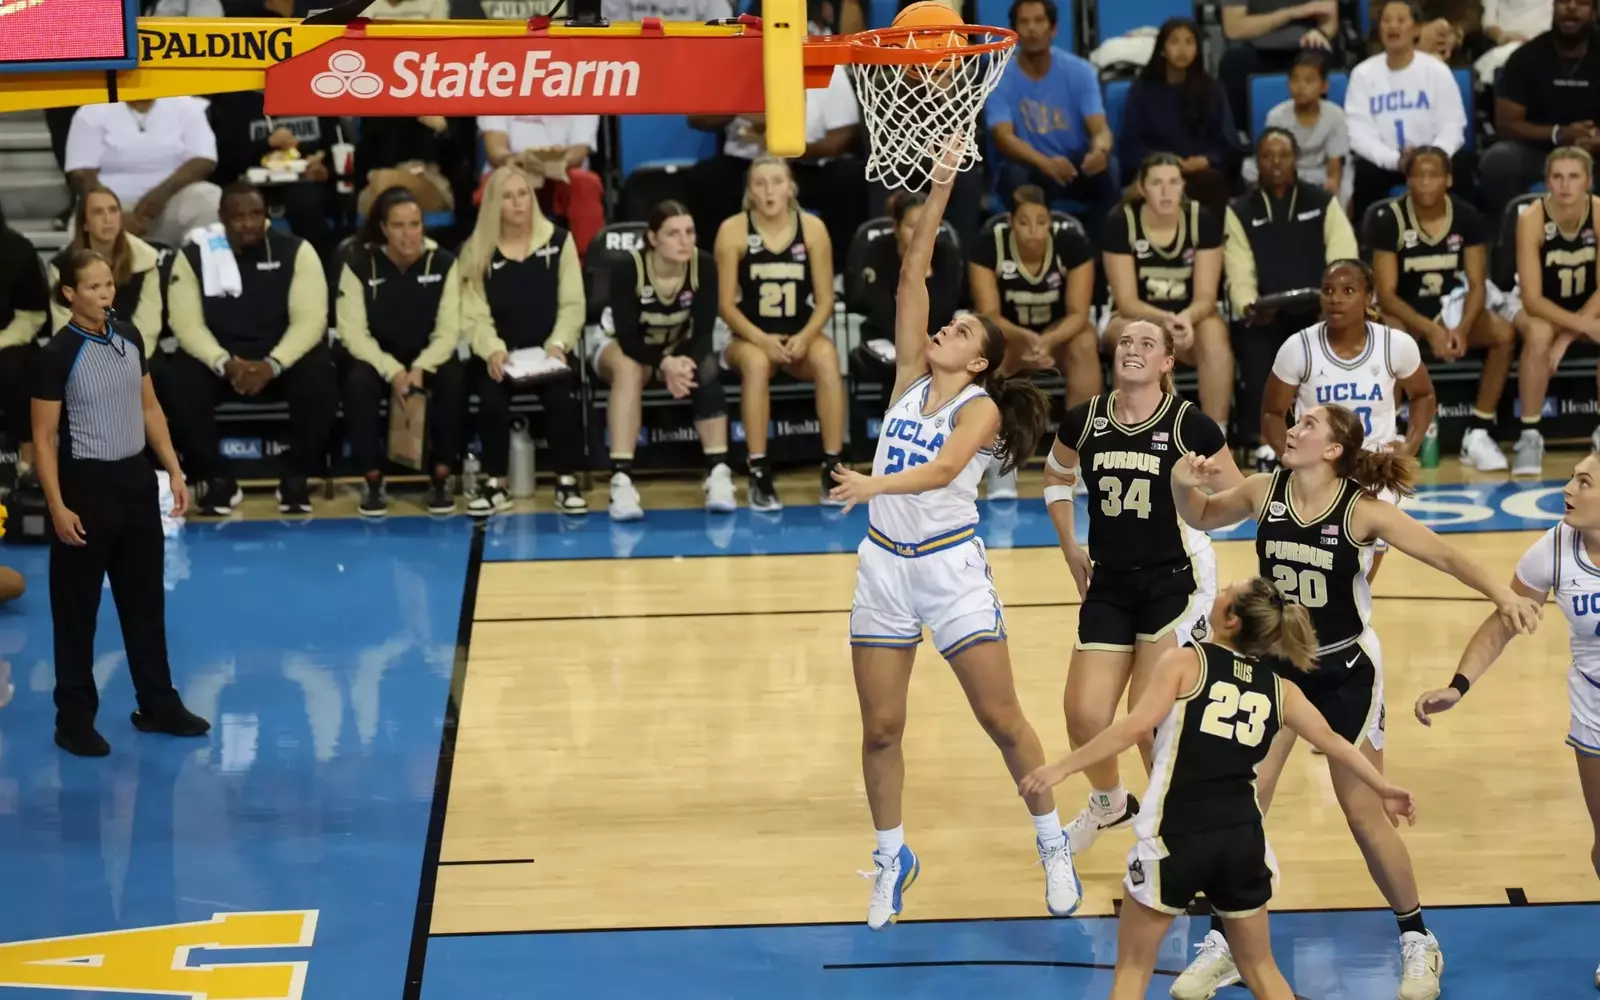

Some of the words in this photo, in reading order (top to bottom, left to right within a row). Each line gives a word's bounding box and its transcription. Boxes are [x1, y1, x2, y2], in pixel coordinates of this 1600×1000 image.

[138, 27, 292, 62] PALDING
[1369, 89, 1430, 115] UCLA
[1558, 265, 1586, 298] 11
[758, 282, 796, 317] 21
[1316, 383, 1383, 404] UCLA
[886, 418, 944, 452] UCLA
[1092, 451, 1161, 476] PURDUE
[1098, 476, 1152, 519] 34
[1265, 540, 1334, 570] PURDUE
[1272, 564, 1328, 608] 20
[1233, 659, 1253, 683] ELLIS
[1199, 680, 1272, 748] 23
